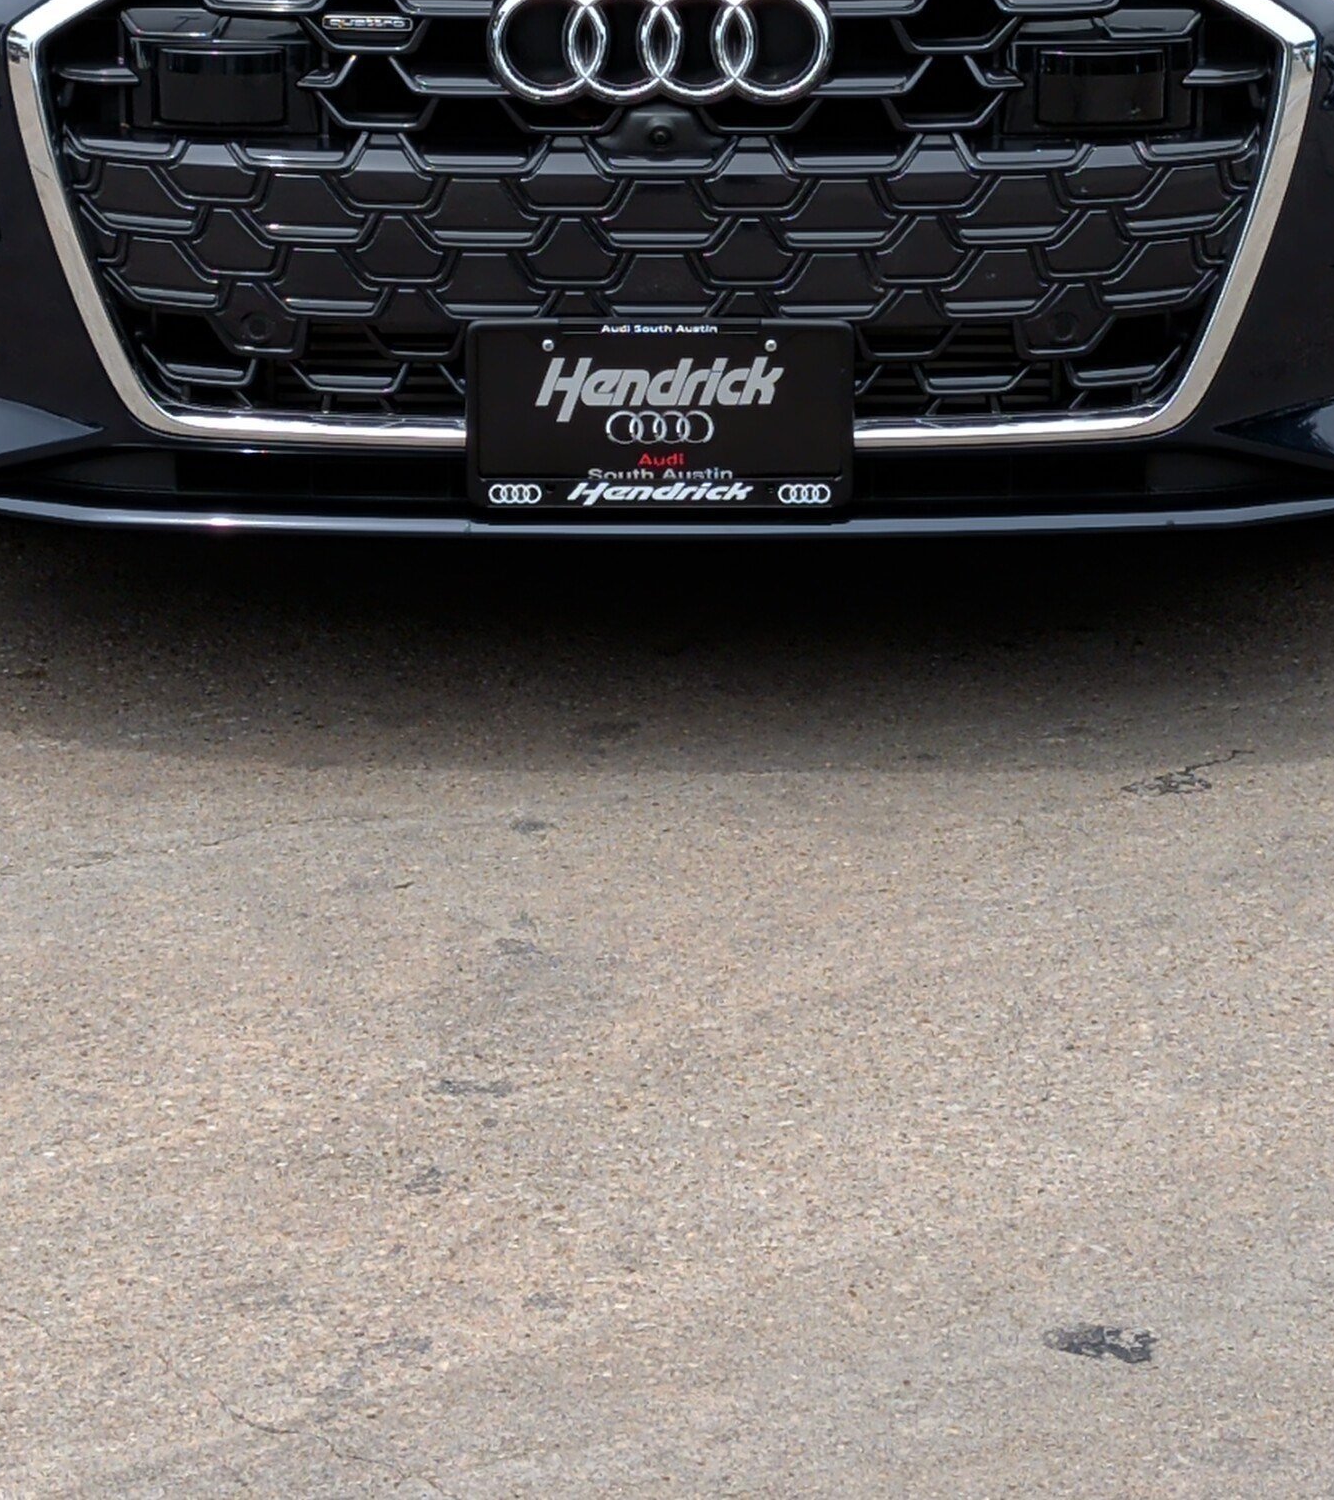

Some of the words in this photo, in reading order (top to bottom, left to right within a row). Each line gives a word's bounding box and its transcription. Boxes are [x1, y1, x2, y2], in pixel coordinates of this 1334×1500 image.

[329, 17, 406, 29] quattro
[601, 324, 631, 333] Audi
[634, 324, 672, 333] South
[675, 324, 719, 333] Austin
[535, 356, 785, 422] Hendrick
[637, 452, 685, 467] Audi
[587, 467, 655, 479] South
[662, 467, 733, 479] Austin
[567, 482, 754, 506] Hendrick
